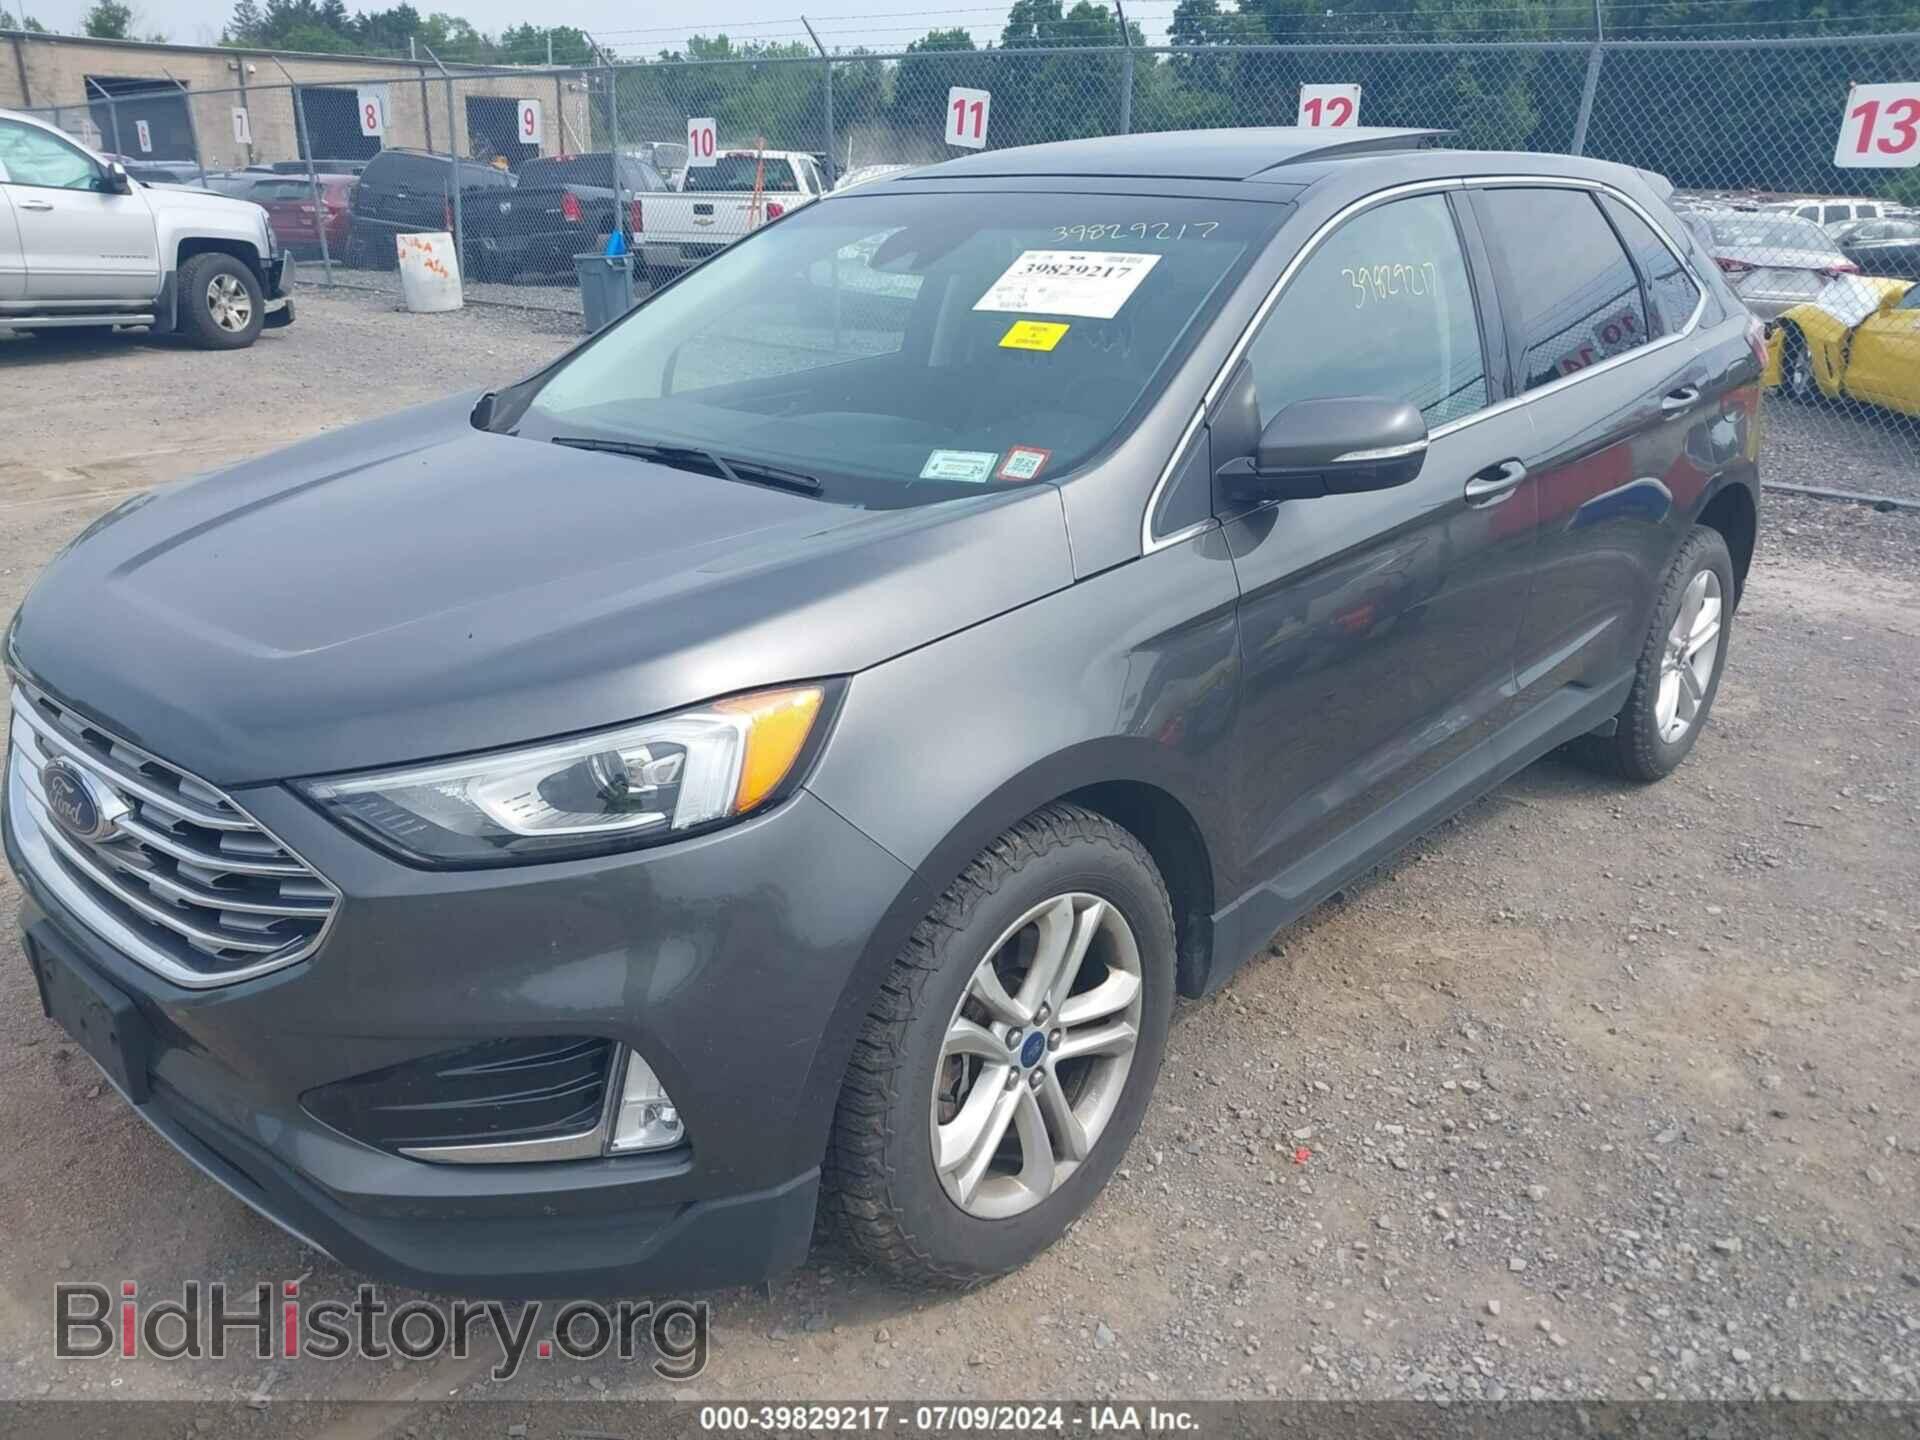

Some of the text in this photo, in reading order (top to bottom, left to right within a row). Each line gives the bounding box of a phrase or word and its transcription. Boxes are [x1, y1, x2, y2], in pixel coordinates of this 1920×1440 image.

[365, 104, 377, 129] 8
[524, 108, 534, 136] 9
[953, 99, 984, 138] 11
[1304, 97, 1353, 127] 12
[1851, 98, 1920, 154] 13
[690, 127, 714, 157] 10
[1052, 222, 1219, 242] 39829217
[1018, 261, 1132, 281] 39829217
[49, 776, 82, 825] Ford
